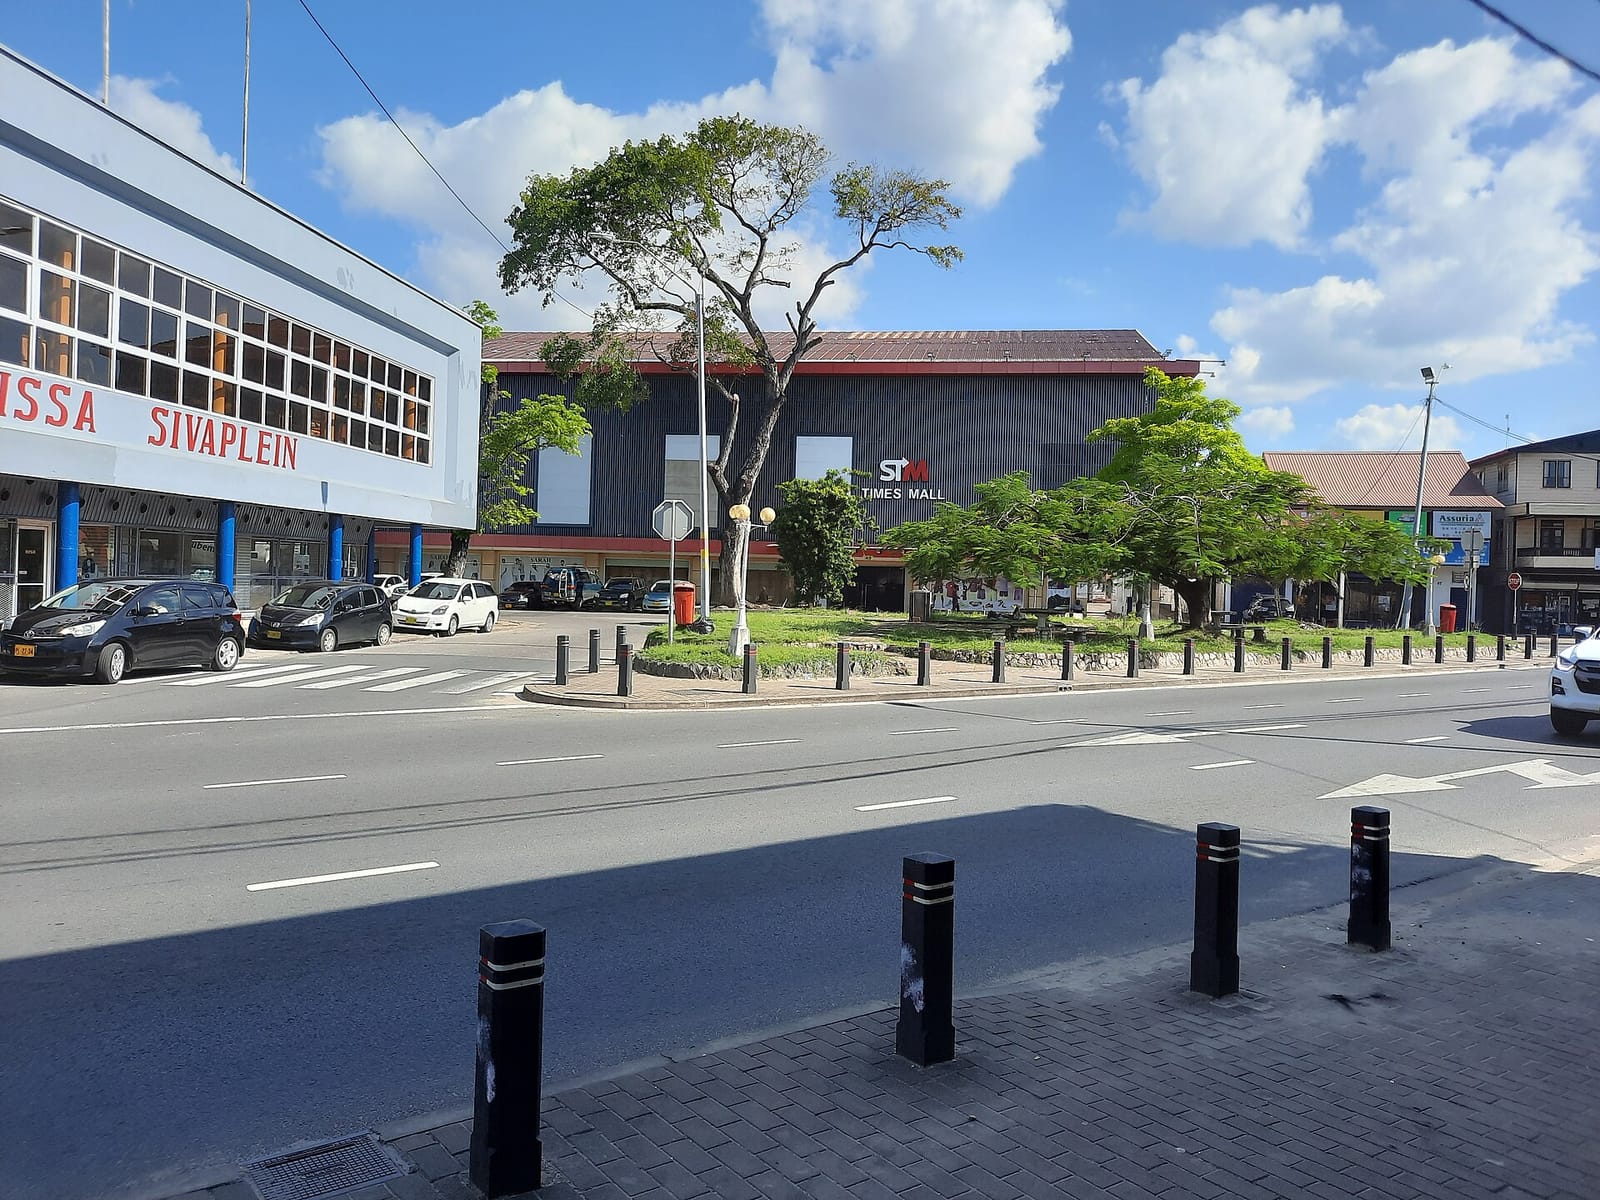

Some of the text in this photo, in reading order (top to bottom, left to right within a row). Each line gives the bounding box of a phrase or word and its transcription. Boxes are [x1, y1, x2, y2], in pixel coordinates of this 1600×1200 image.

[147, 406, 298, 470] SIVAPLEIN
[879, 457, 929, 482] STM
[861, 488, 945, 500] TIMES MALL
[1439, 514, 1474, 522] Assuria
